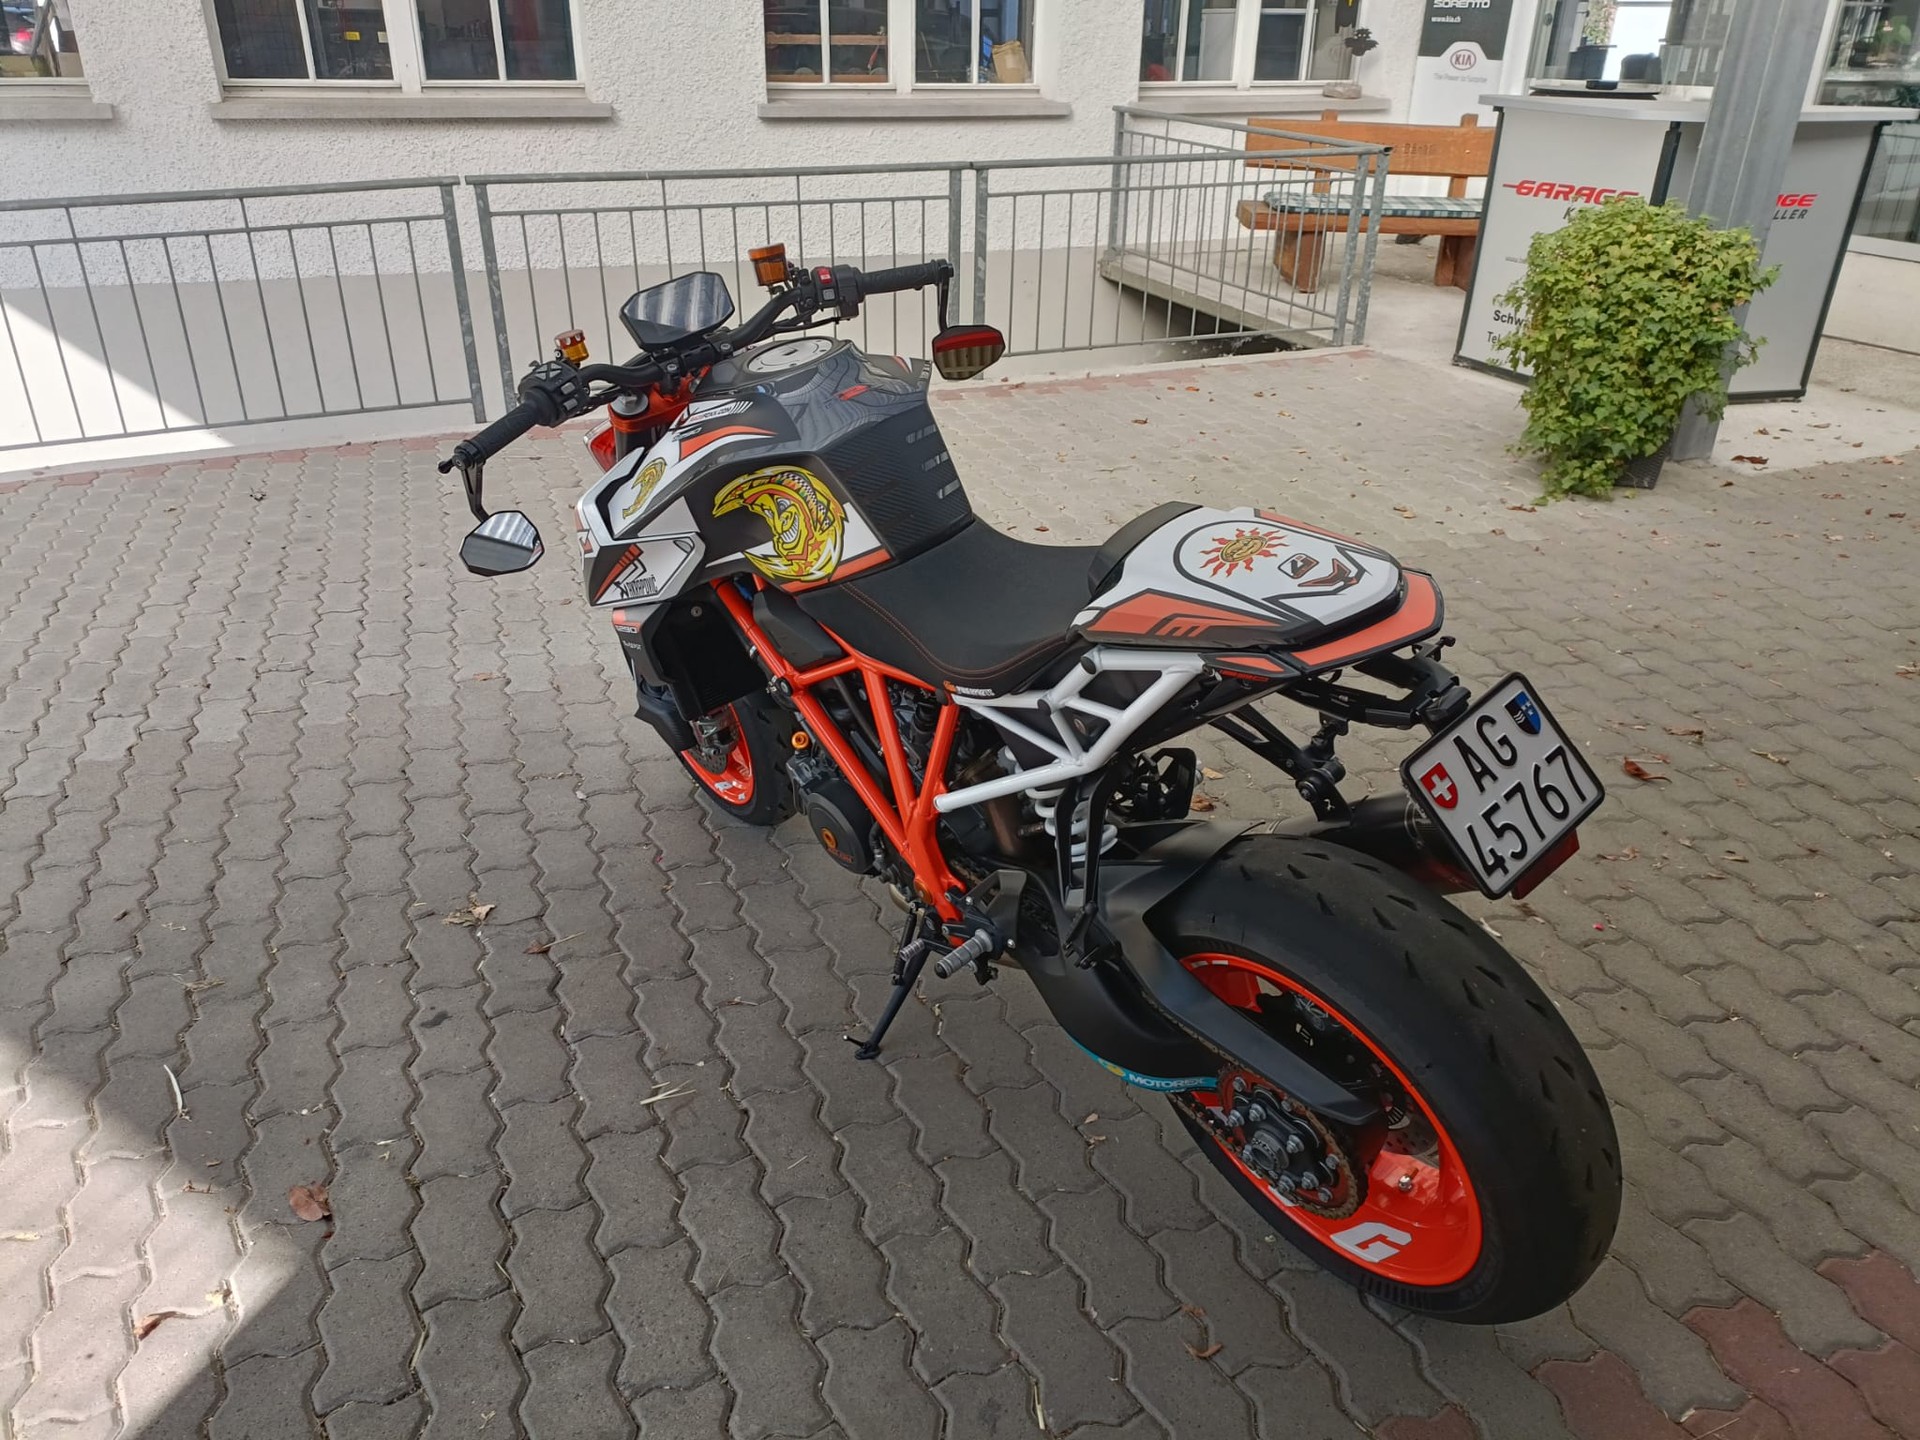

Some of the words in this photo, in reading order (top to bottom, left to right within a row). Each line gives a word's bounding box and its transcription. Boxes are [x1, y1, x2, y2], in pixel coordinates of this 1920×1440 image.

[1454, 54, 1472, 66] KIA
[1453, 715, 1518, 793] AG
[1466, 746, 1587, 877] 45767
